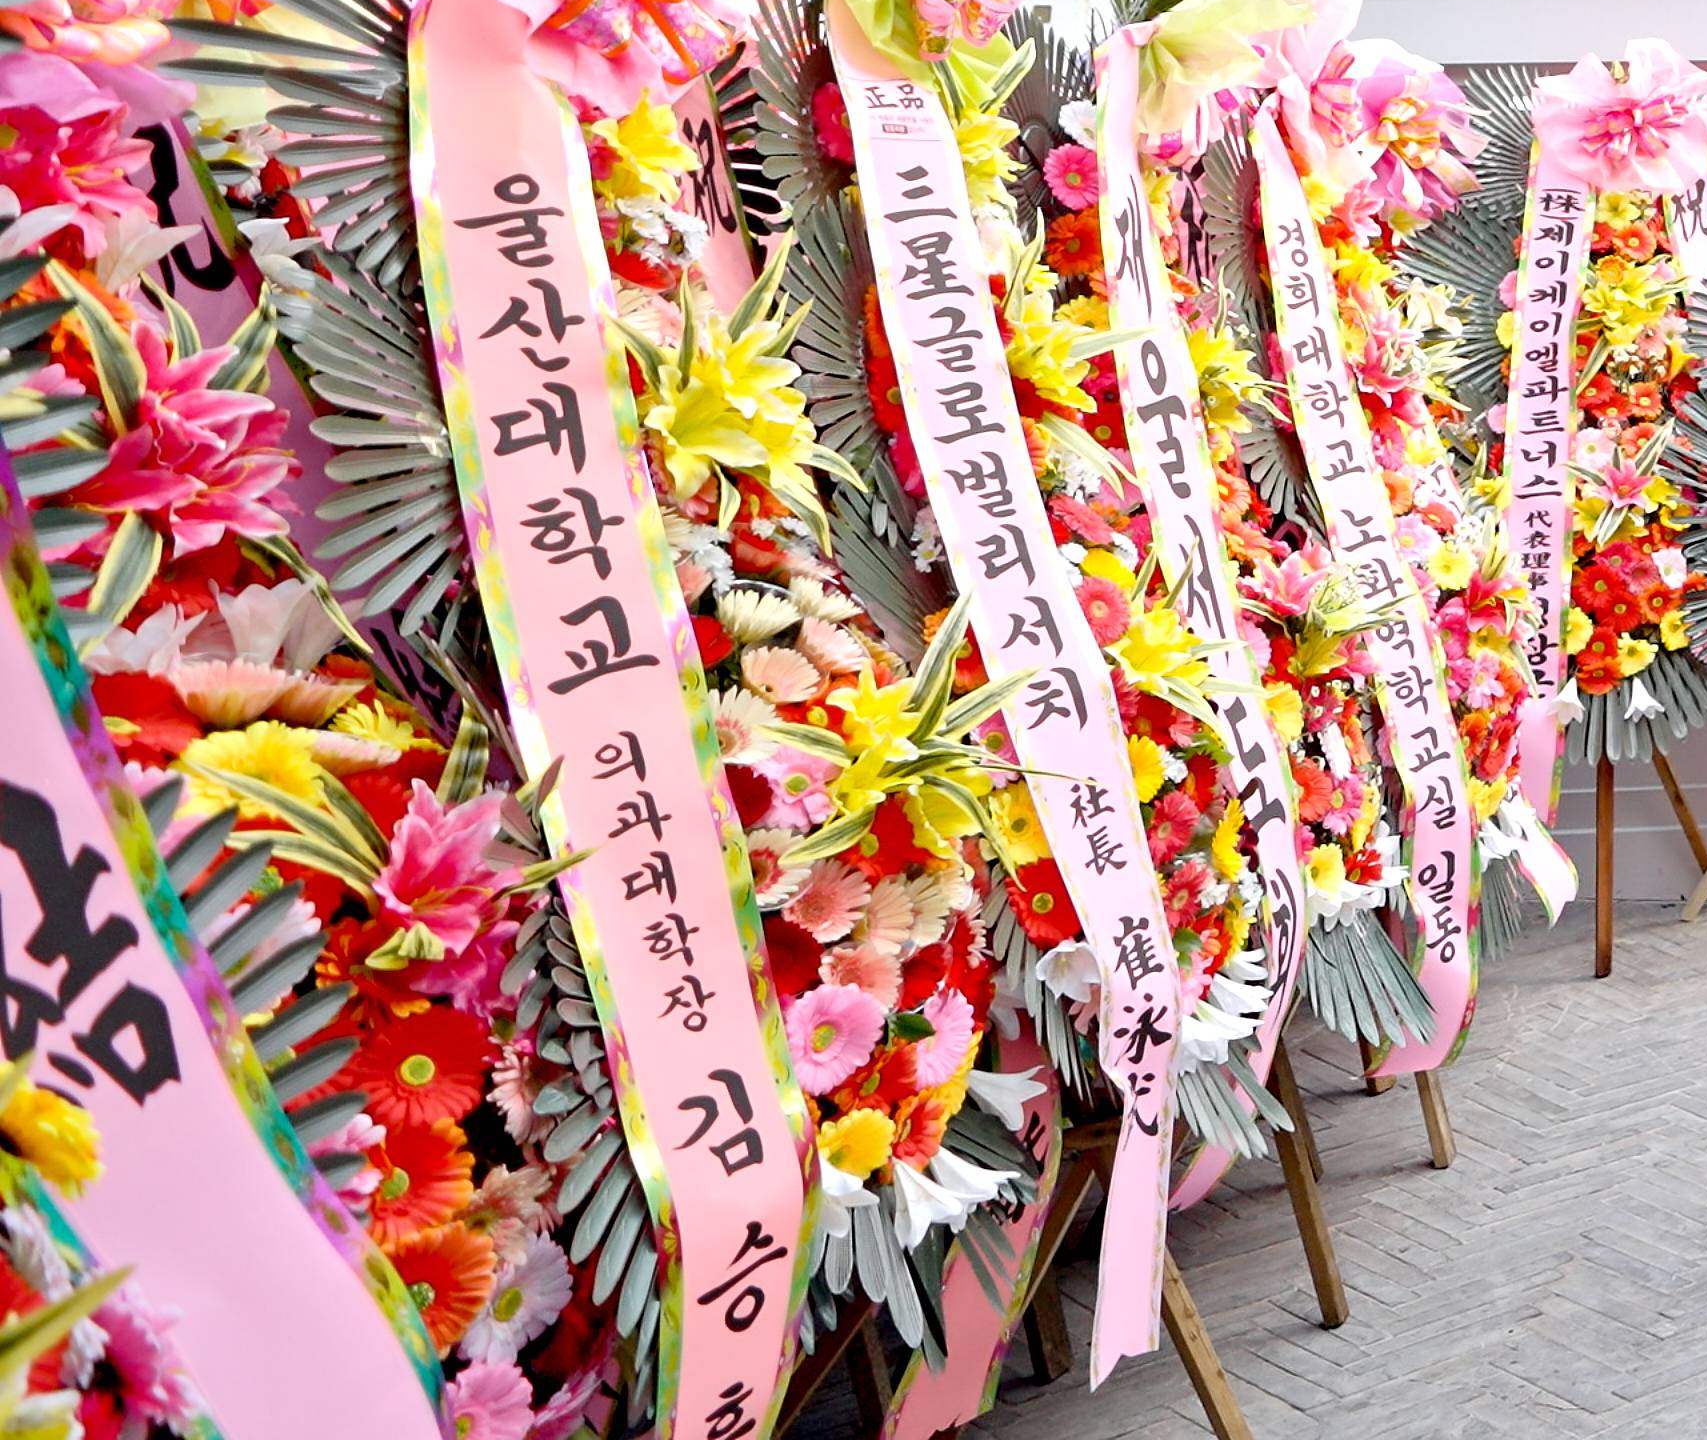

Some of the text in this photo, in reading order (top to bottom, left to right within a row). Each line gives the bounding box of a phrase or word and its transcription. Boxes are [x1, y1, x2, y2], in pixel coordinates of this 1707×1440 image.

[864, 83, 924, 109] 正品
[454, 173, 660, 695] 울산대학교
[592, 730, 715, 1032] 의과대학장
[883, 164, 1087, 732] 三星글로벌리서치
[1070, 777, 1127, 876] 社長
[1279, 218, 1365, 481] 경희대학교
[1417, 850, 1462, 963] 일동
